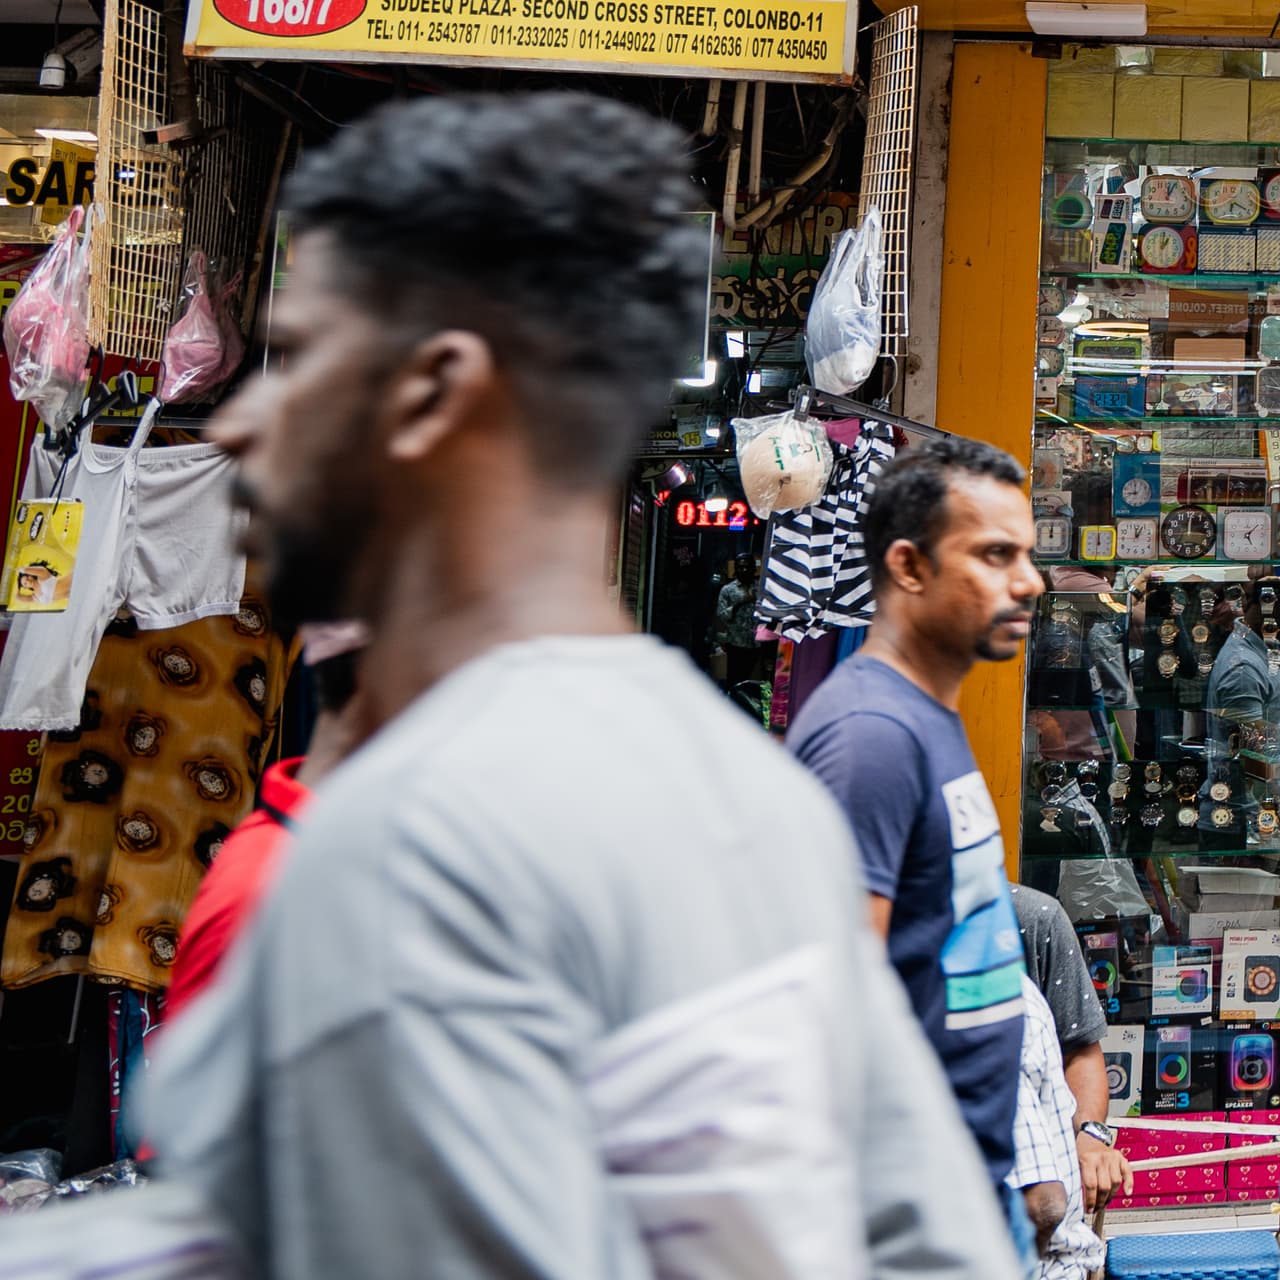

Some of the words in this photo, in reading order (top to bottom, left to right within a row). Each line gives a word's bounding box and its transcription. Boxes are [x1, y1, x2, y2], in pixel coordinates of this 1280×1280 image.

[594, 0, 650, 26] CROSS
[653, 4, 719, 32] STREET,
[723, 7, 824, 34] COLONBO-11
[366, 19, 395, 41] TEL:
[428, 22, 481, 45] 2543787
[490, 25, 569, 49] 011-2332025
[578, 29, 656, 54] 011-2449022
[666, 32, 688, 55] 077
[690, 33, 743, 58] 4162636
[752, 36, 774, 58] 077
[776, 37, 828, 61] 4350450
